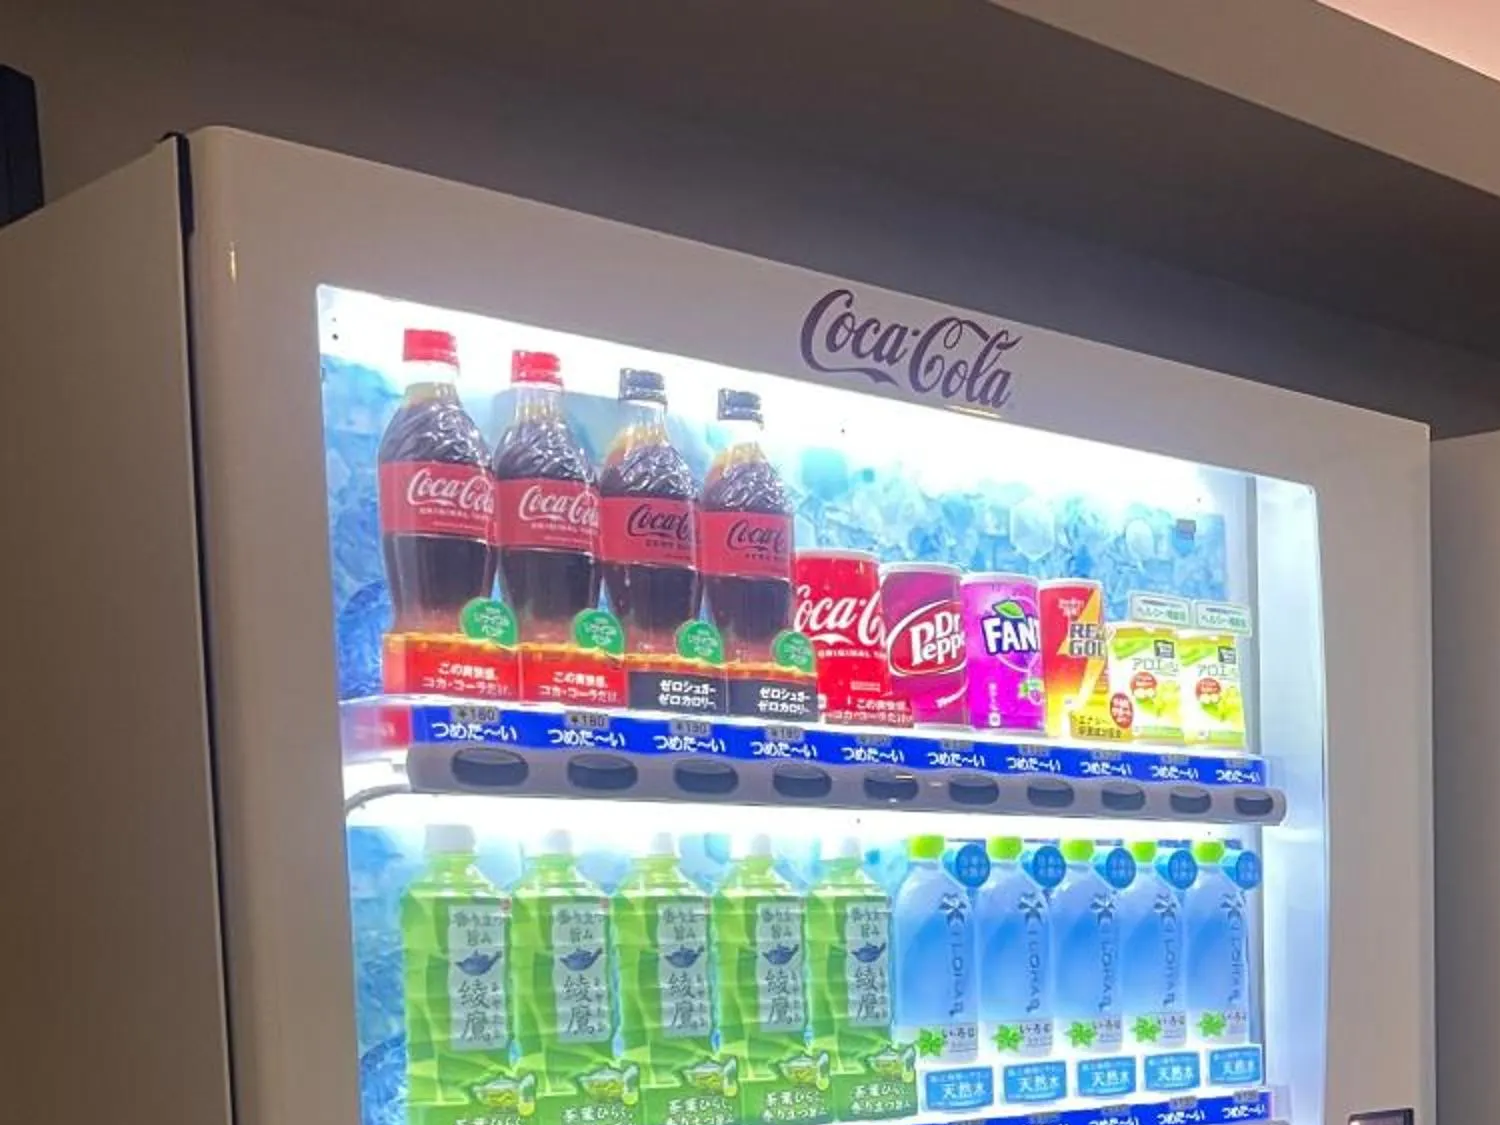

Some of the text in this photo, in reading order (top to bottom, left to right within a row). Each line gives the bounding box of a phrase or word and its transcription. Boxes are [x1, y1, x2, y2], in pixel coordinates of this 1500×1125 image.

[800, 289, 1021, 409] Coca-Cola
[942, 1082, 986, 1099] 天然水
